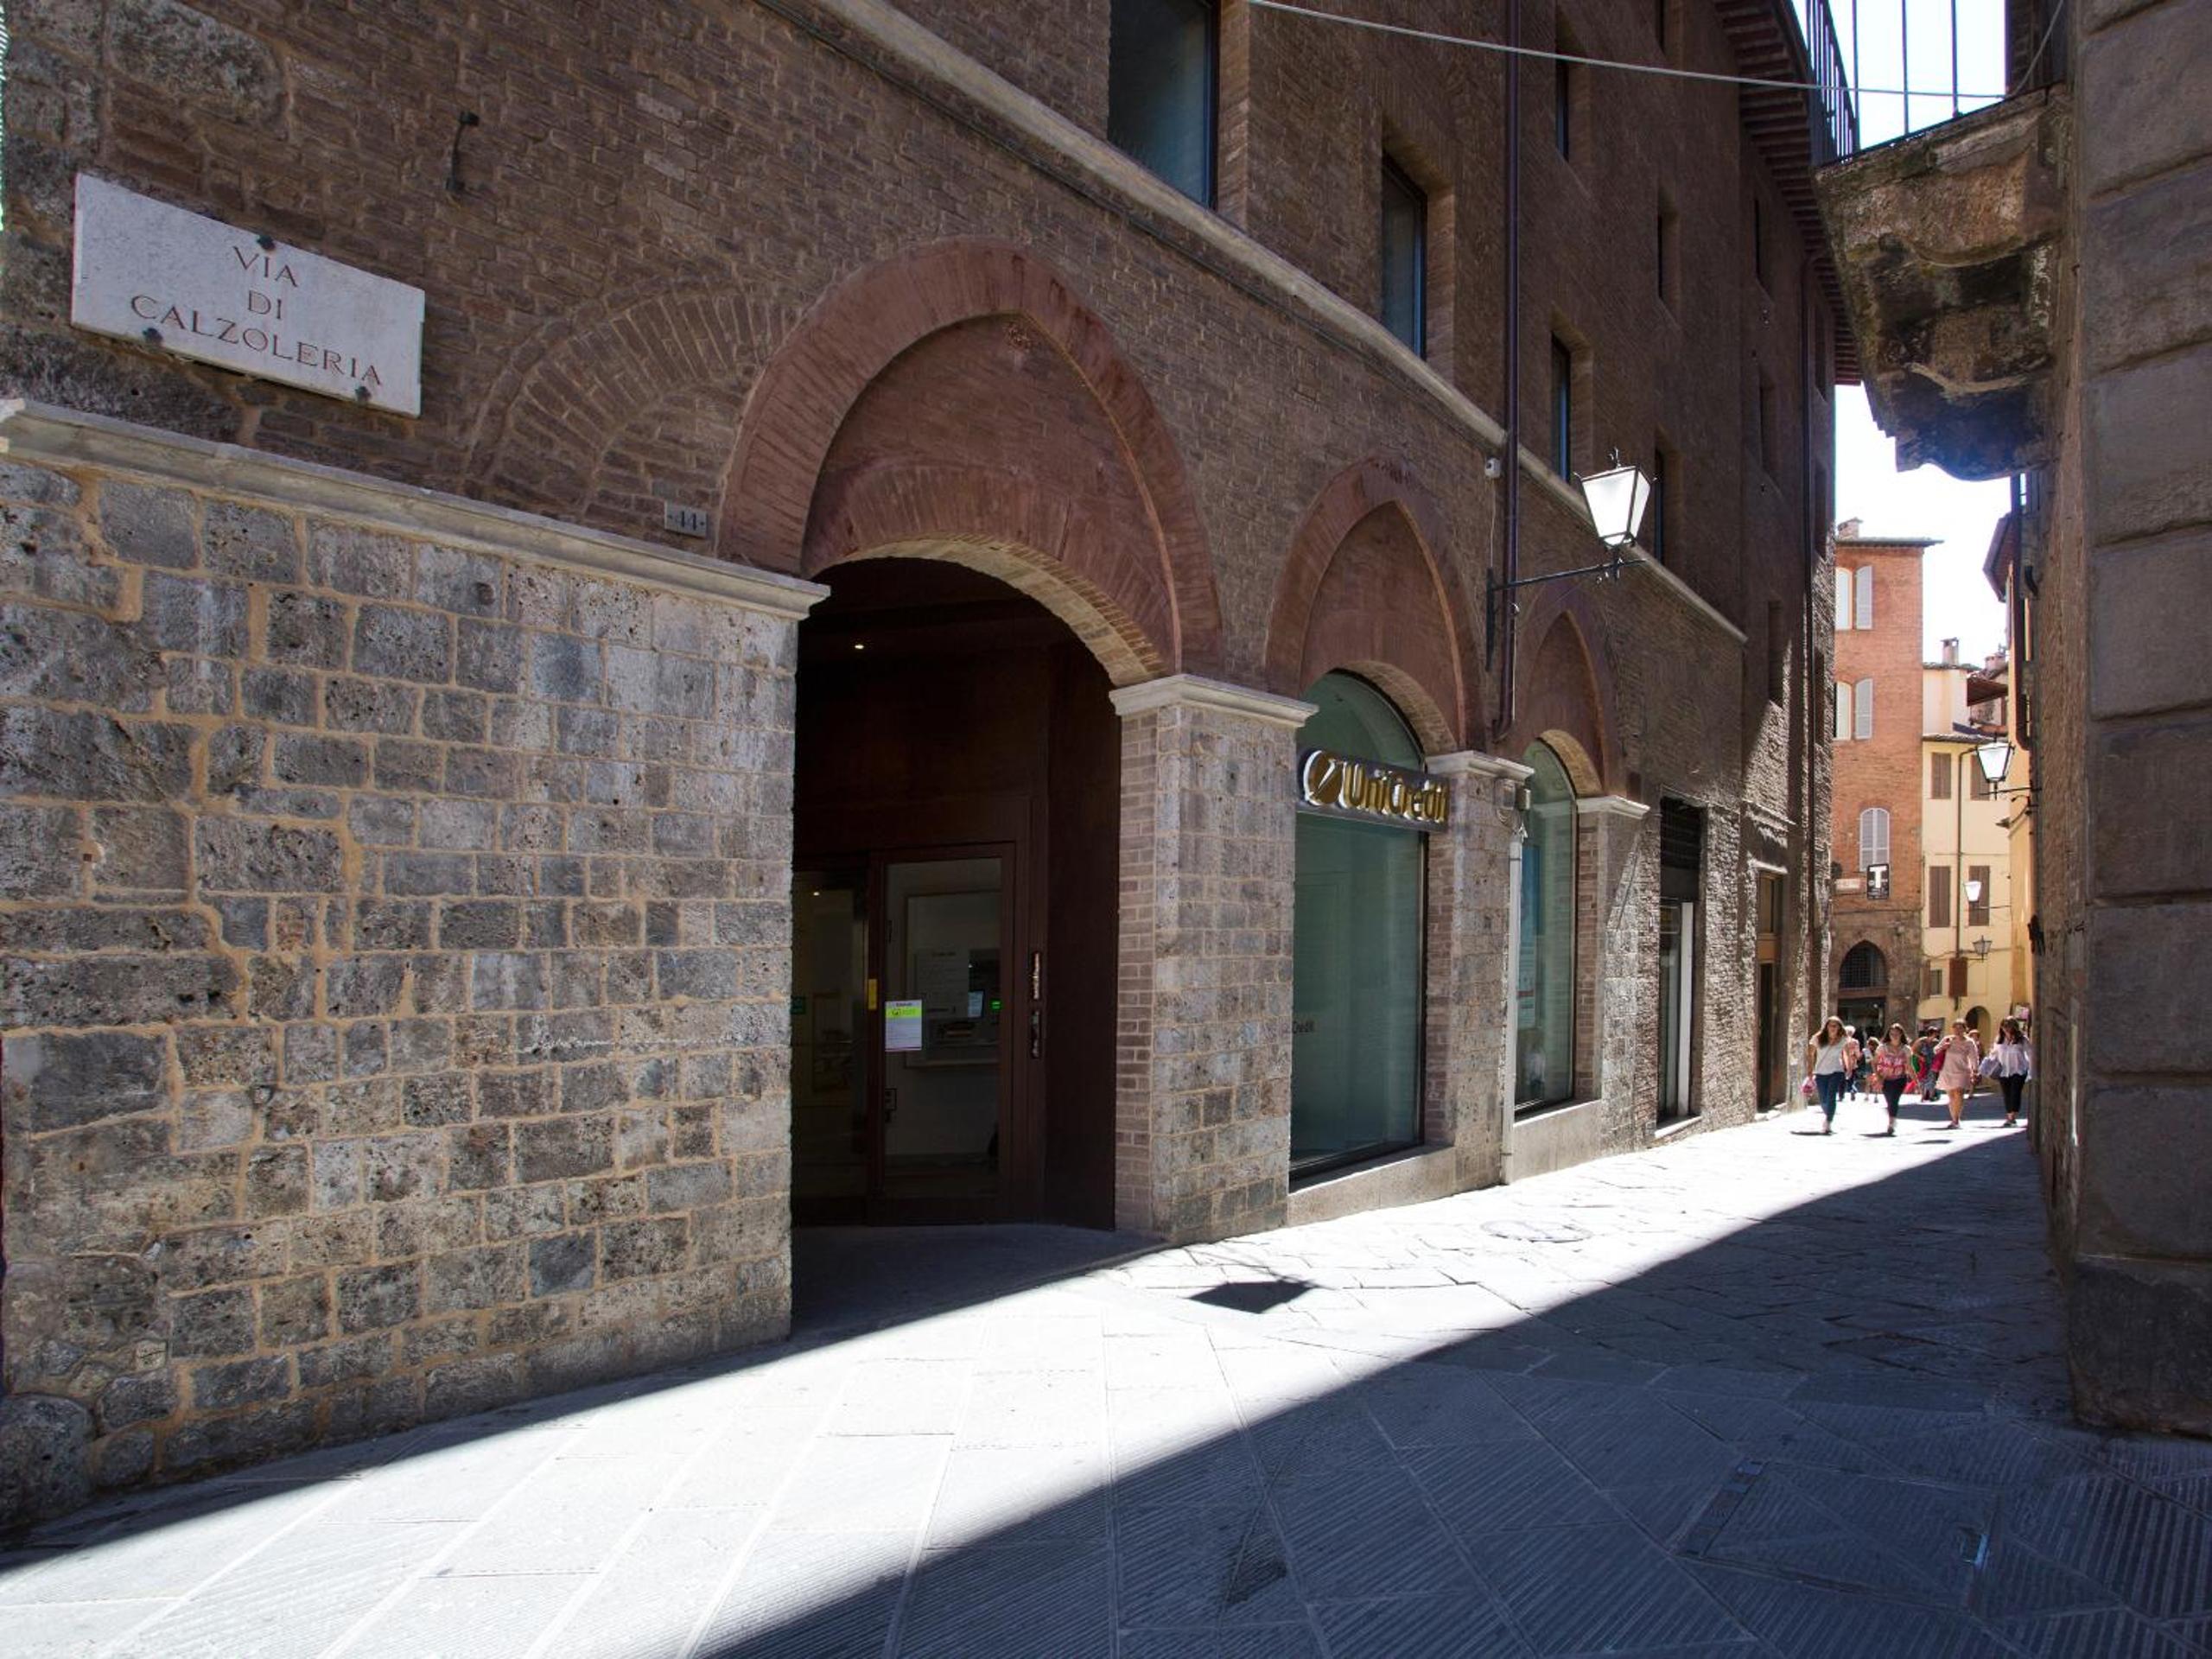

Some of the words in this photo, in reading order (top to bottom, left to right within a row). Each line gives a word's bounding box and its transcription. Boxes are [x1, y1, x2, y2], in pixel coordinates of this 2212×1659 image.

[233, 245, 297, 287] VIA
[247, 290, 283, 320] DI
[130, 294, 382, 385] CALZOLERIA
[1339, 761, 1448, 823] UniCredit
[1869, 866, 1887, 888] T
